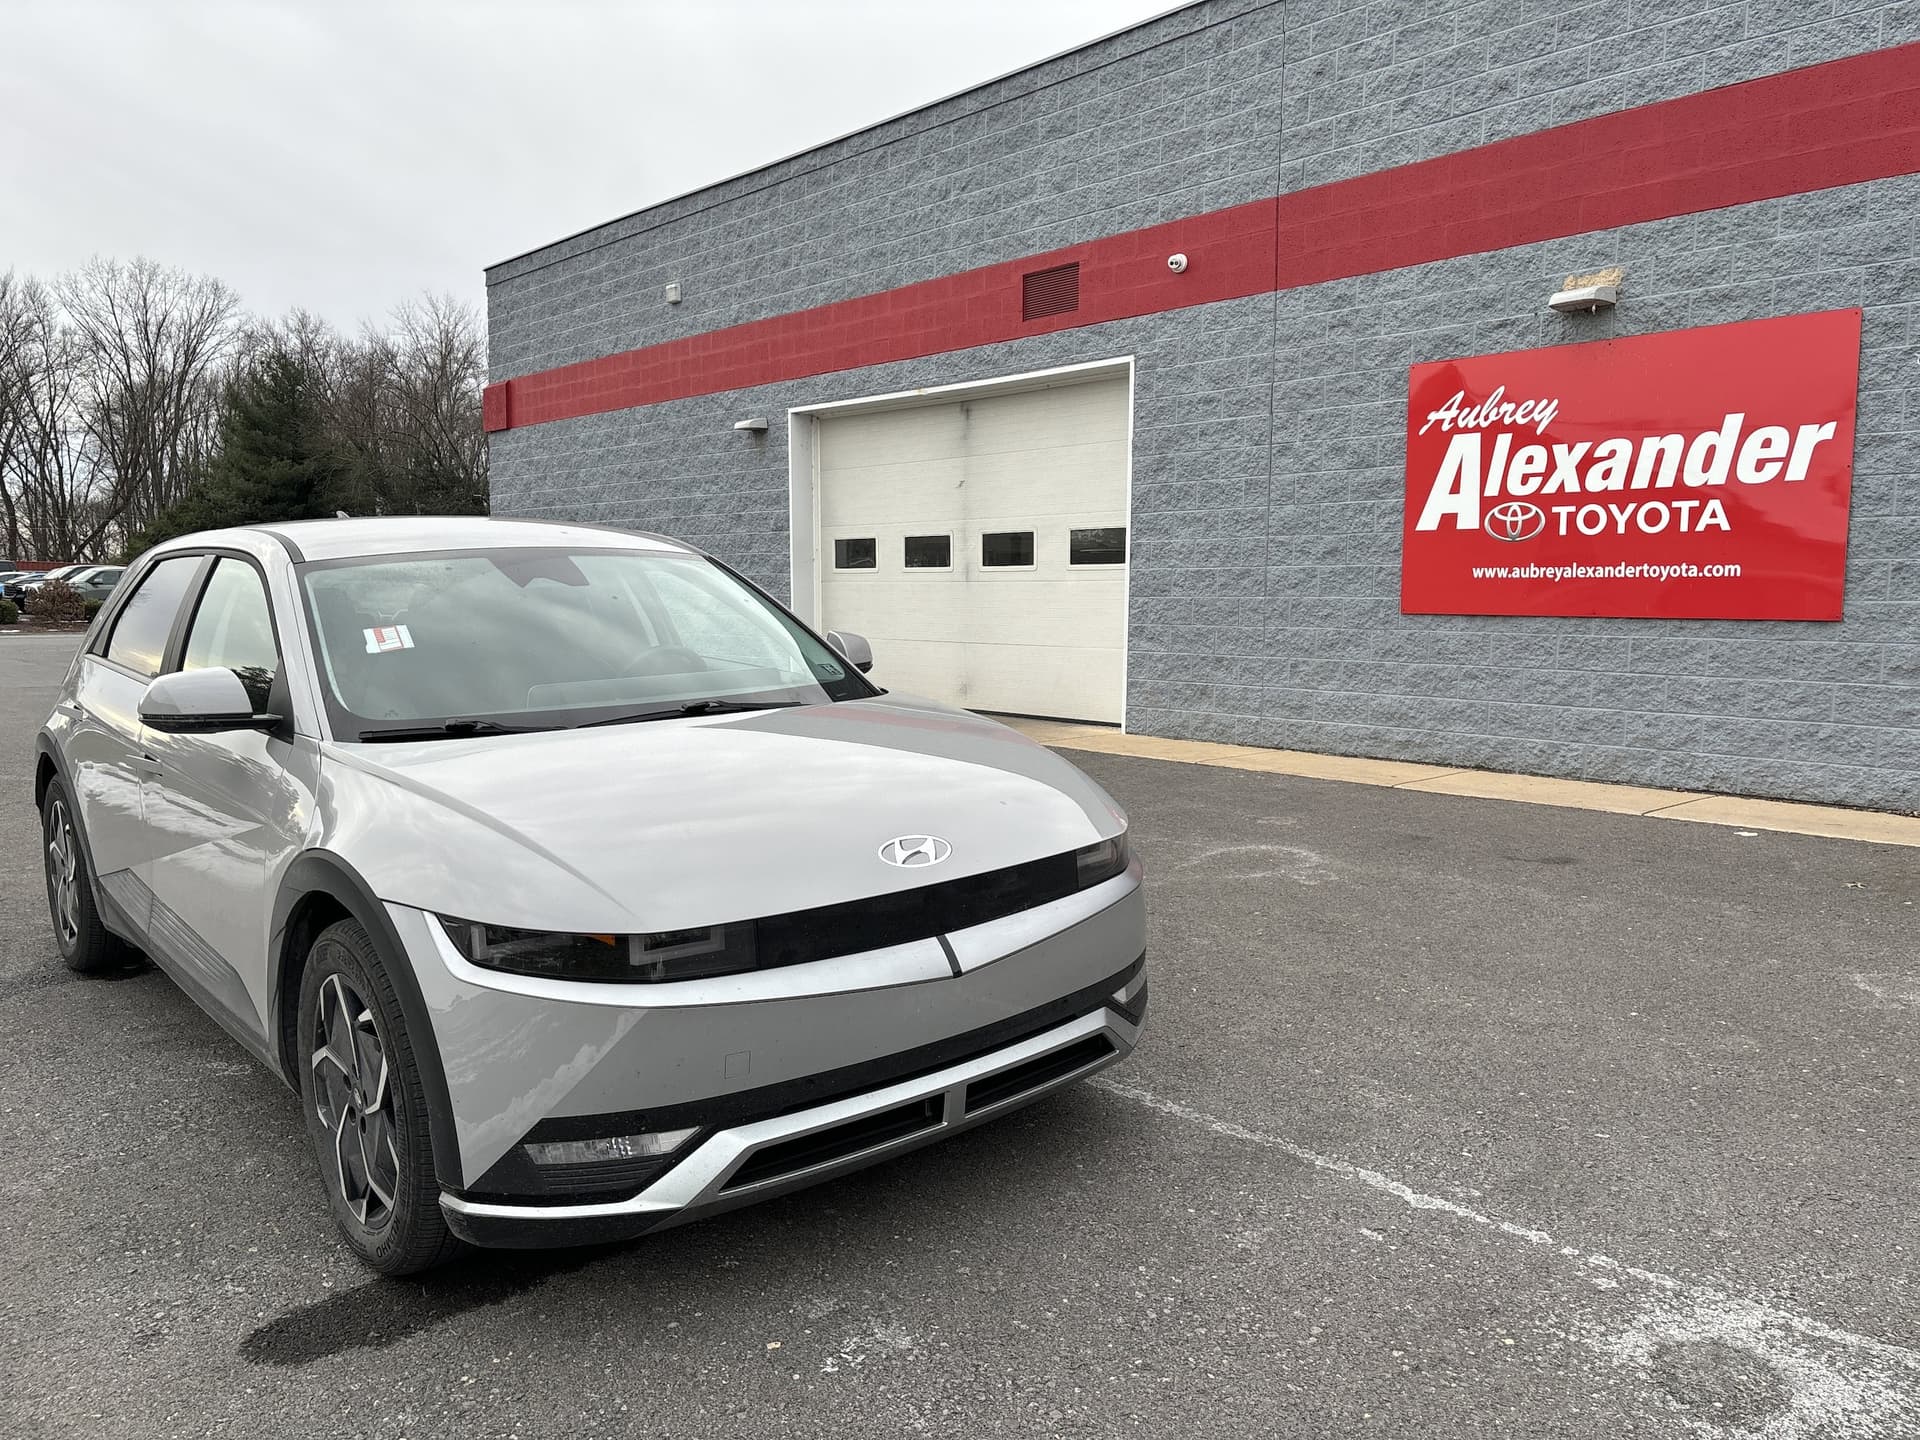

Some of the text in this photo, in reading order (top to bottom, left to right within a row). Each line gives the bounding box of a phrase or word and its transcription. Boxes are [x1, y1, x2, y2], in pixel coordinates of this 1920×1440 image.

[1419, 385, 1559, 435] Aubrey
[1415, 412, 1838, 531] Alexander
[1552, 500, 1731, 536] TOYOTA
[1472, 562, 1741, 582] www.aubreyalexandertoyota.com
